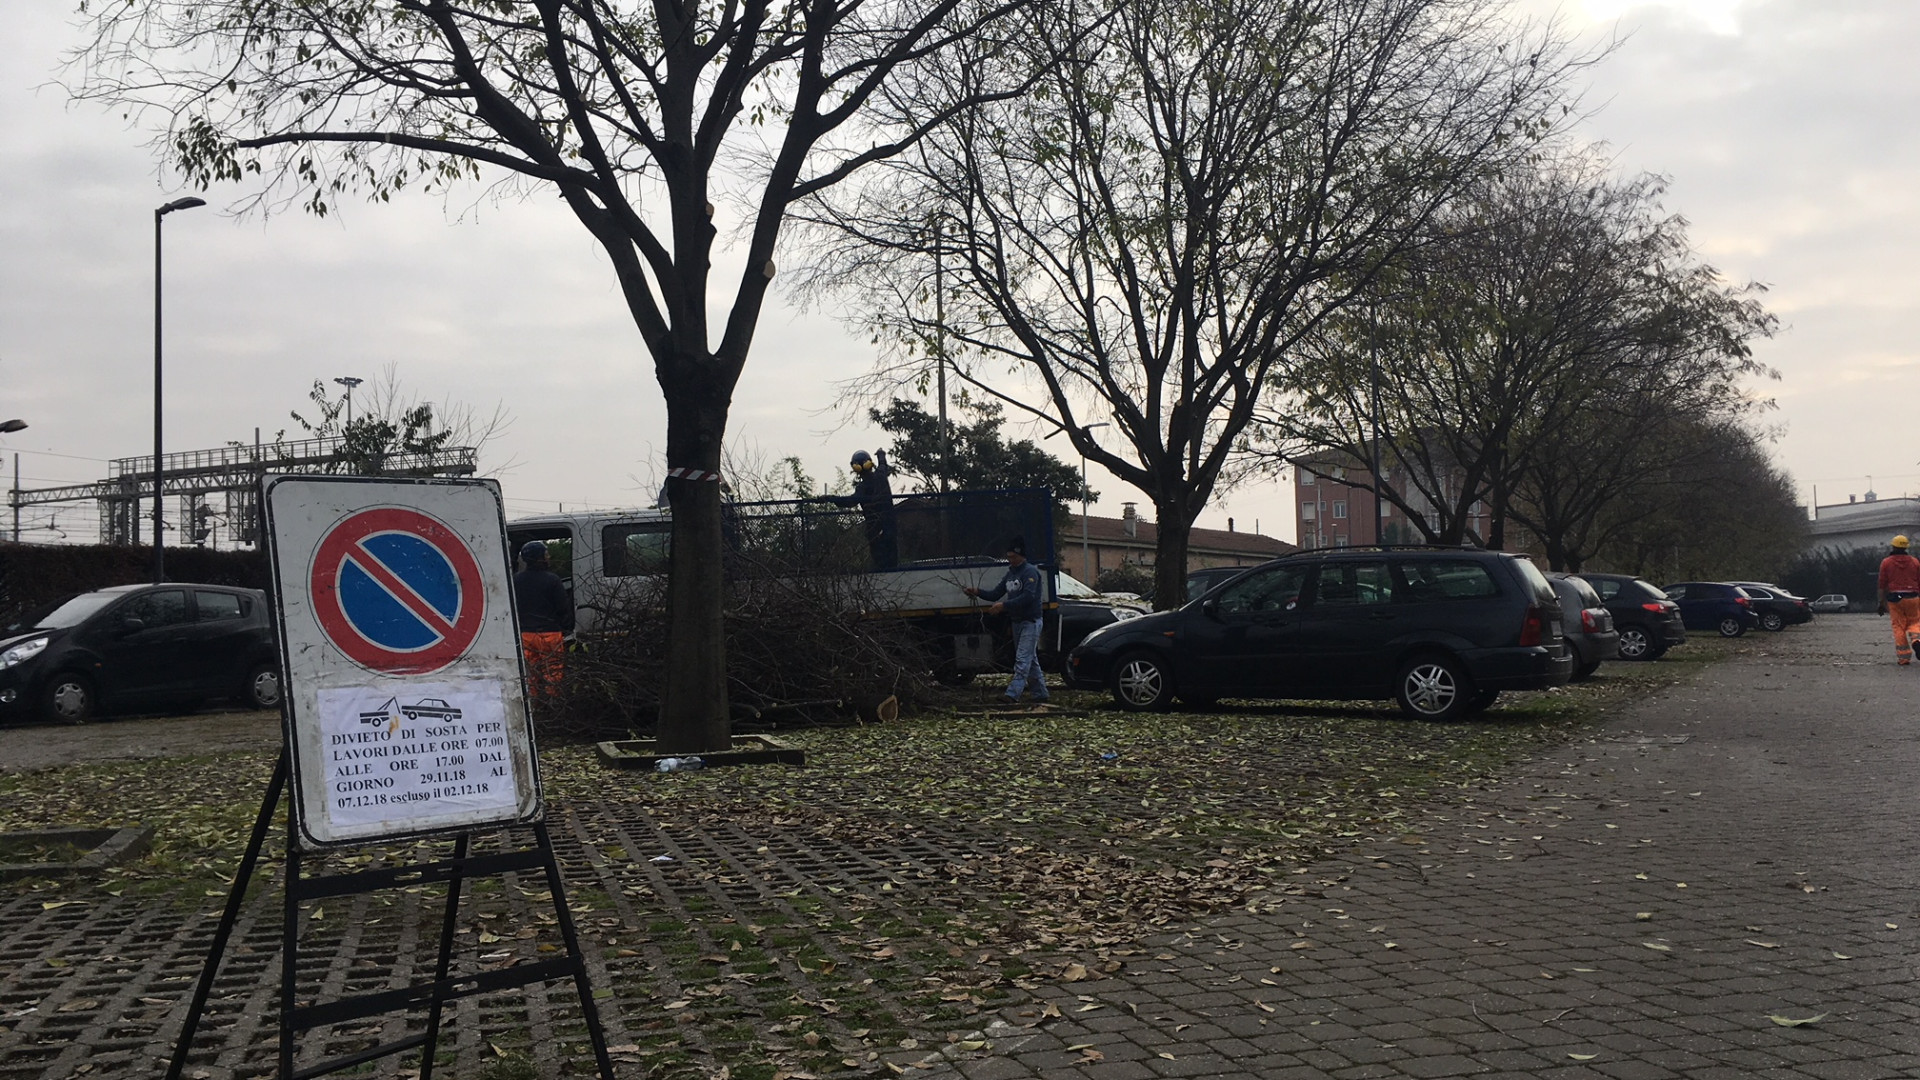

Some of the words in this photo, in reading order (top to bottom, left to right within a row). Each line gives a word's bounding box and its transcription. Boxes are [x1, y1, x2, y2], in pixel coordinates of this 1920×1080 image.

[332, 731, 391, 745] DIVIETO
[402, 729, 415, 739] DI
[426, 725, 467, 737] SOSTA
[477, 723, 501, 733] PER
[333, 748, 388, 761] LAVORI
[393, 743, 437, 755] DALLE
[441, 739, 469, 751] ORE
[476, 737, 503, 748] 07.00
[335, 764, 372, 777] ALLE
[390, 760, 418, 772] ORE
[436, 755, 464, 767] 17.00
[480, 752, 506, 763] DAL
[337, 777, 394, 793] GIORNO
[421, 770, 466, 784] 29.11.18
[491, 767, 507, 777] AL
[338, 794, 387, 809] 07.12.18
[390, 791, 430, 804] escluso
[434, 788, 440, 798] il
[444, 783, 488, 797] 02.12.18
